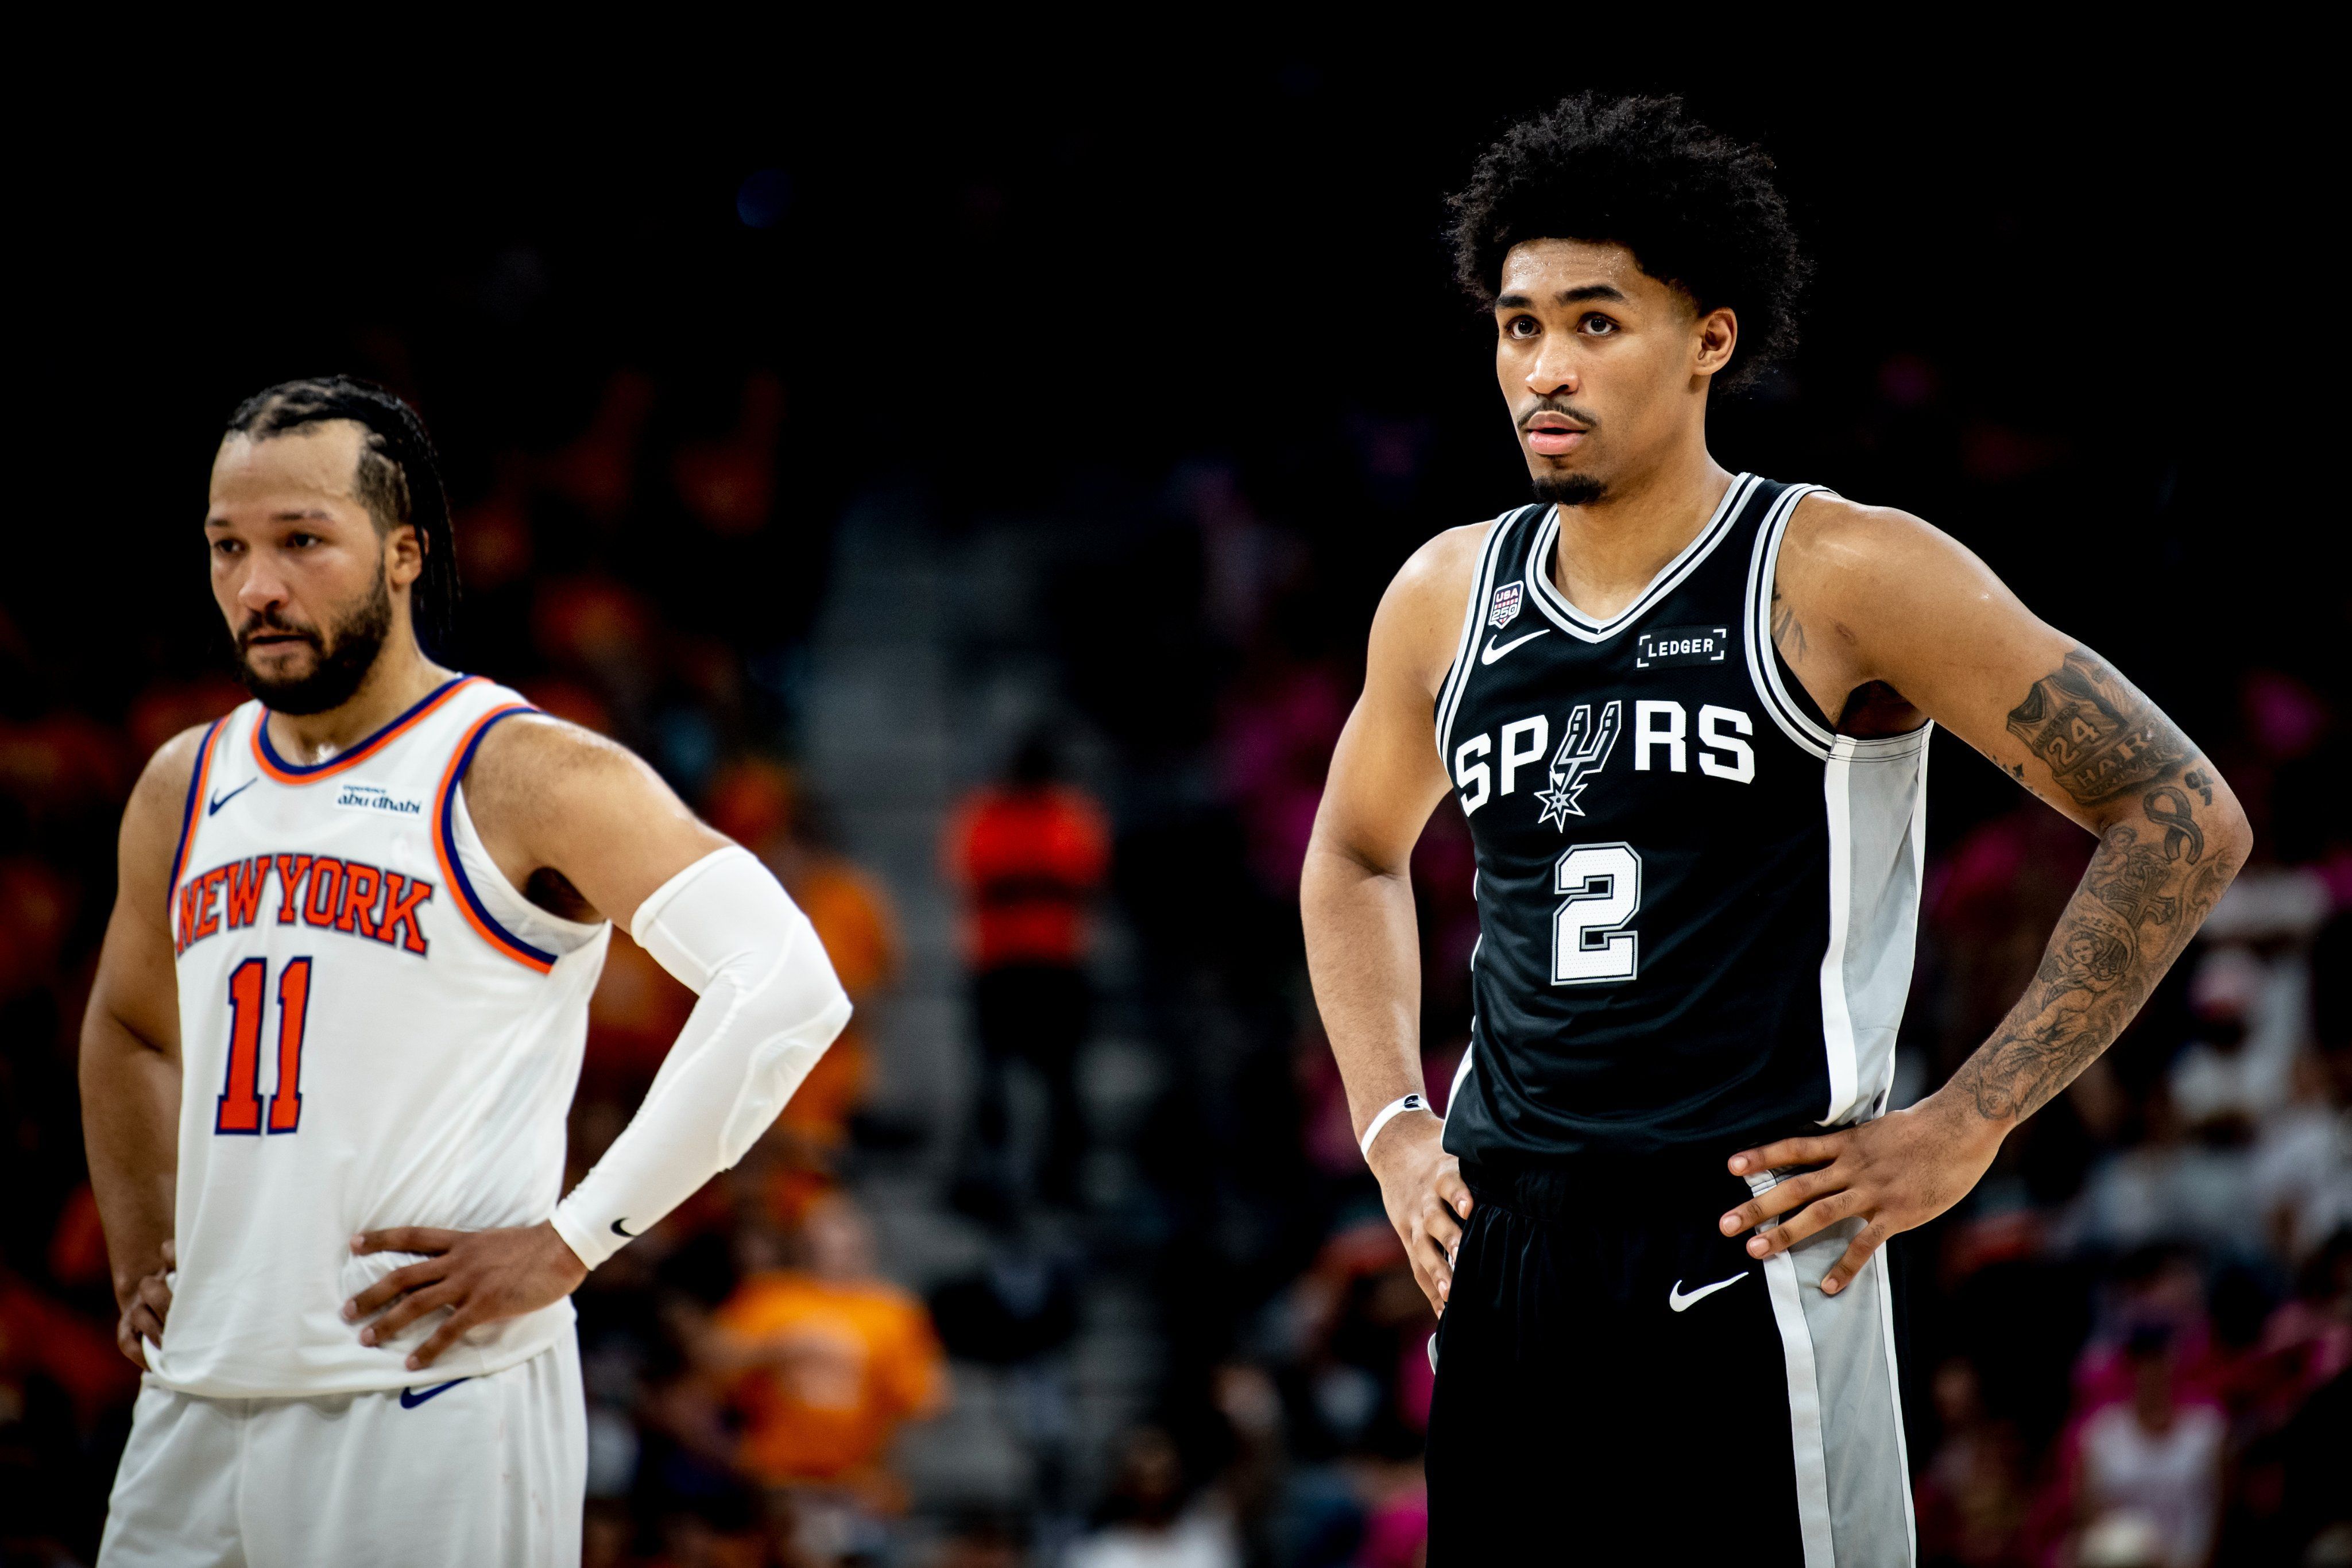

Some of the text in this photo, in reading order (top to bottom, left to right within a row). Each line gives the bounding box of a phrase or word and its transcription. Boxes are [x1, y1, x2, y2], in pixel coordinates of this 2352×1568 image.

[1491, 603, 1518, 621] 250
[1496, 588, 1518, 602] USA
[1648, 638, 1713, 657] LEDGER
[2049, 716, 2100, 765] 24
[1455, 700, 1755, 833] SPURS
[338, 793, 421, 814] abu dhabi
[176, 853, 434, 959] NEW YORK
[1551, 841, 1642, 986] 2
[214, 956, 312, 1135] 11
